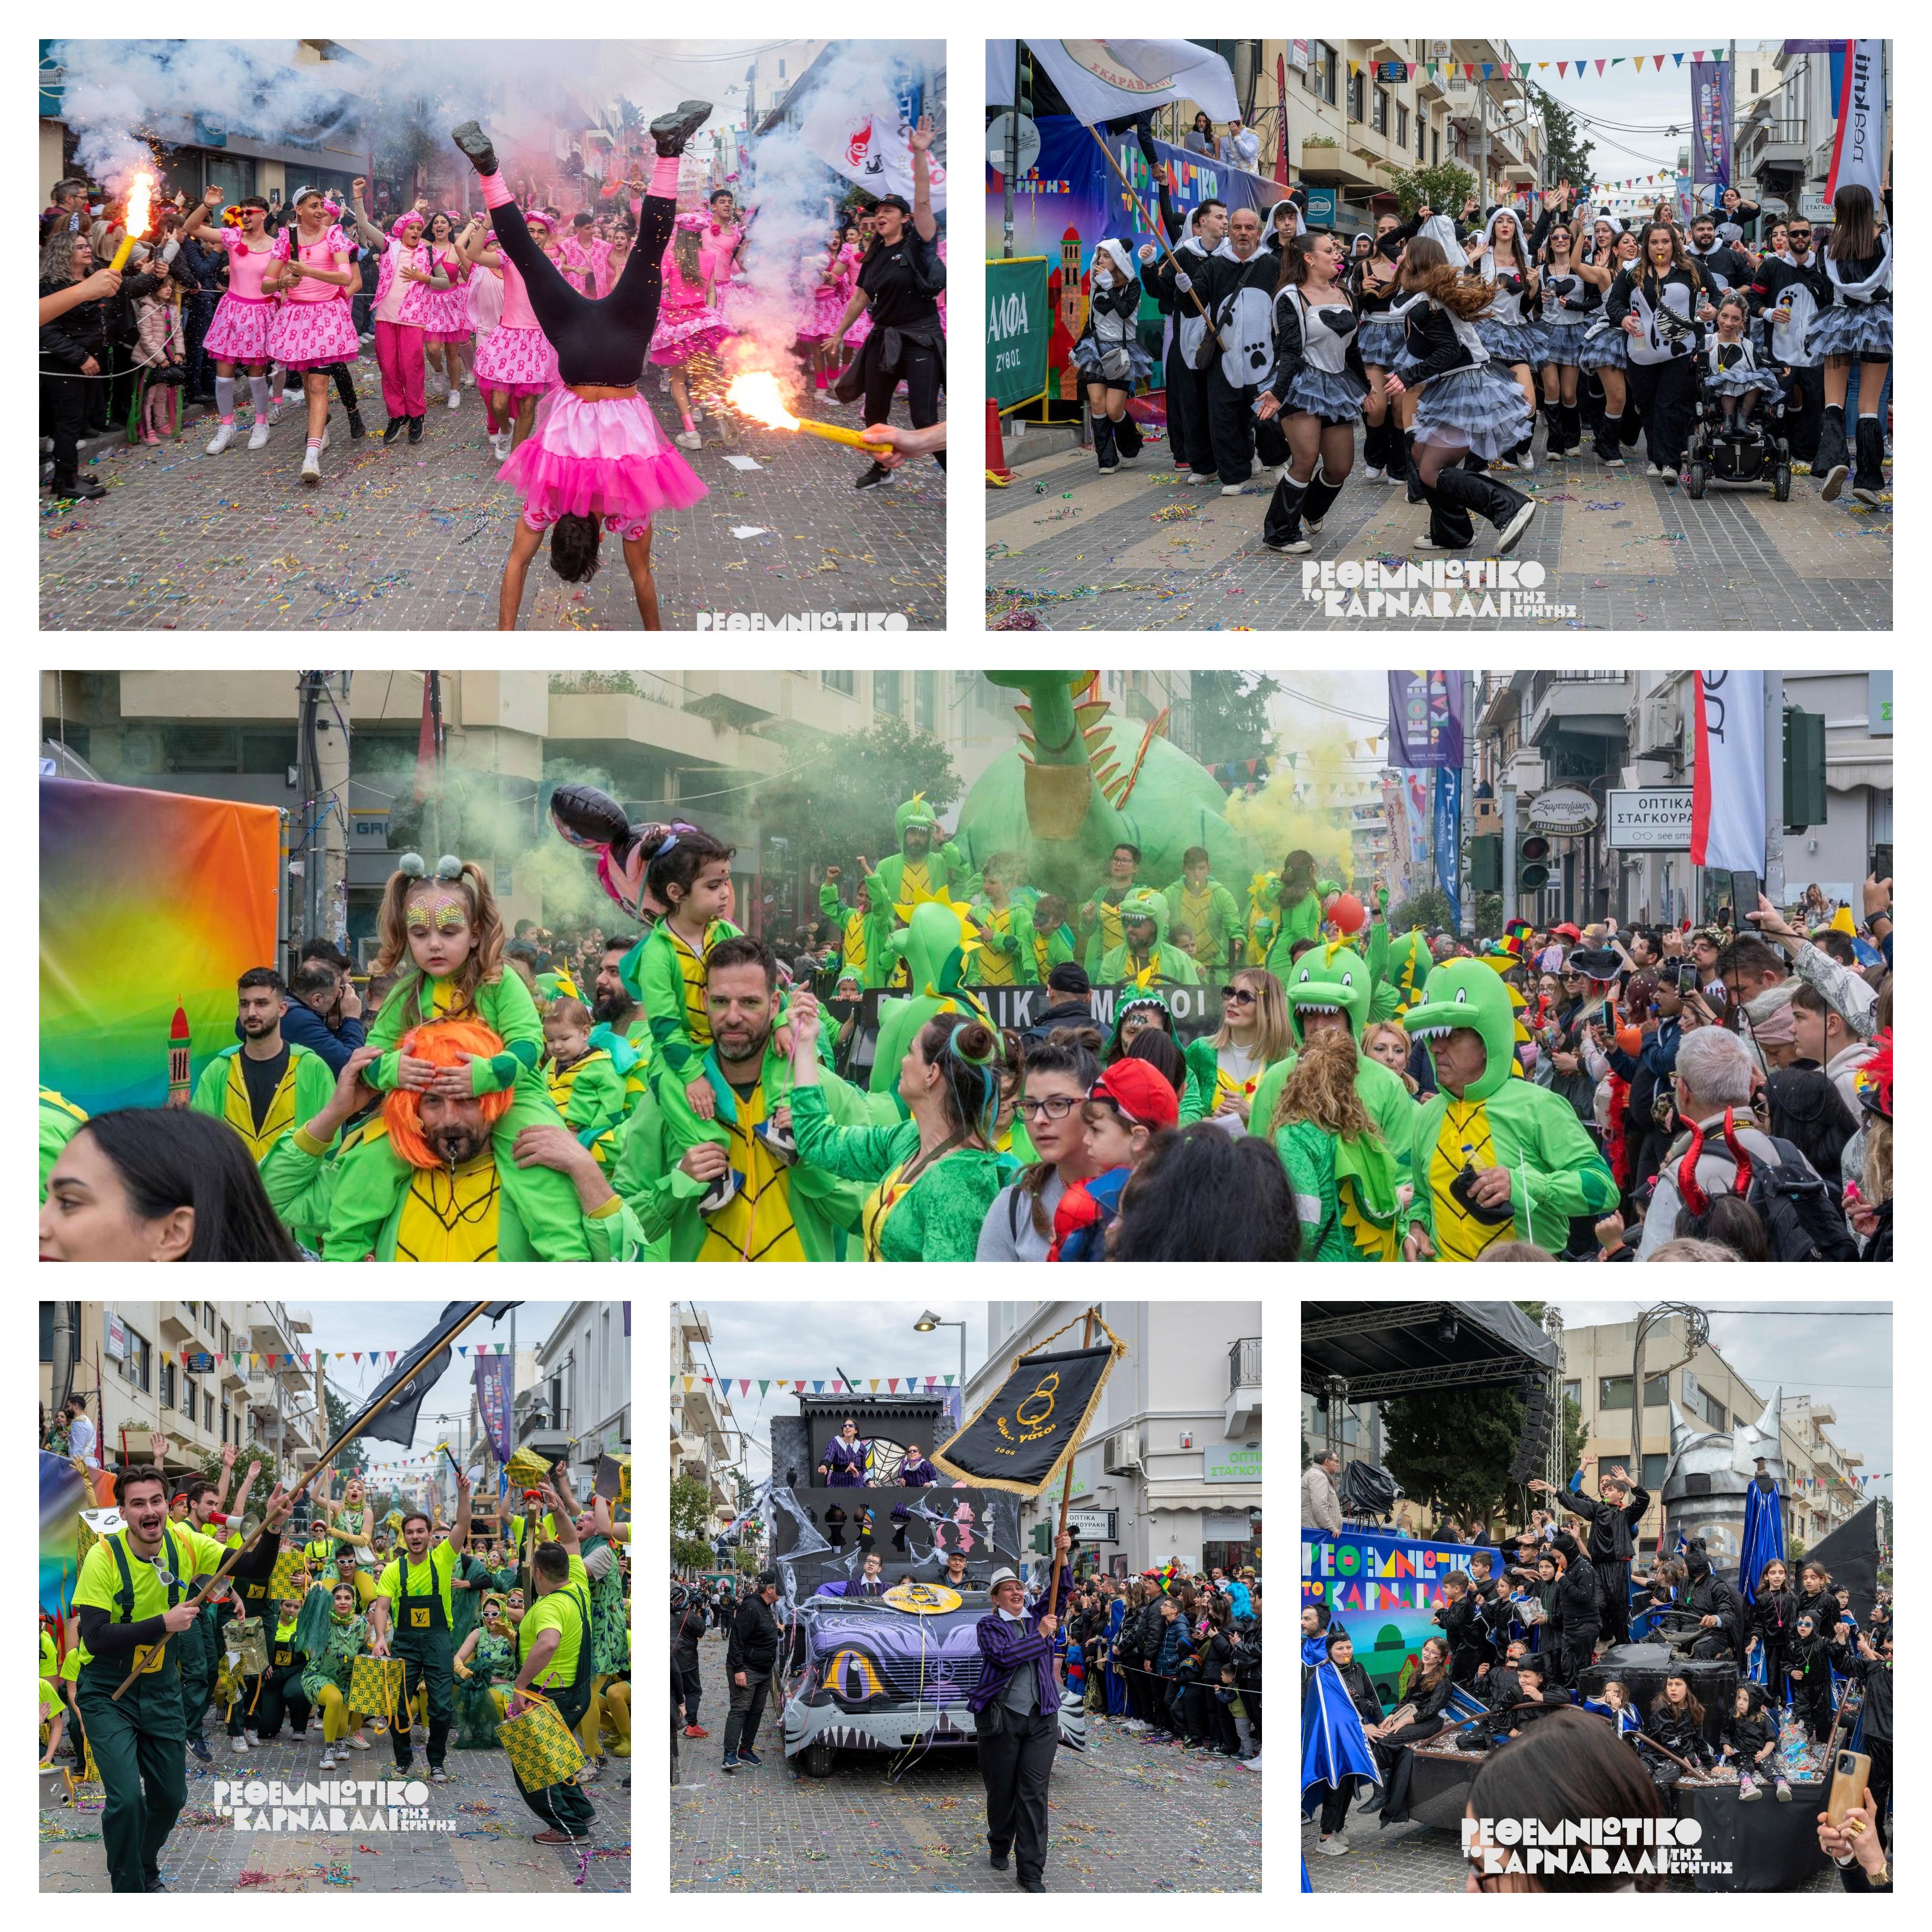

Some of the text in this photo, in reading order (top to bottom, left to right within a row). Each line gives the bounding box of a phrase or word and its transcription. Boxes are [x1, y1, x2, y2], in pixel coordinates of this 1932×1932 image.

[1013, 180, 1070, 193] ΡΗΤΗΣ
[987, 292, 1029, 344] ΑΛΦΑ
[996, 348, 1020, 373] ΖΥΘΟΣ
[1638, 798, 1693, 809] ΟΠΤΙΚΑ
[994, 1447, 1016, 1456] 2006
